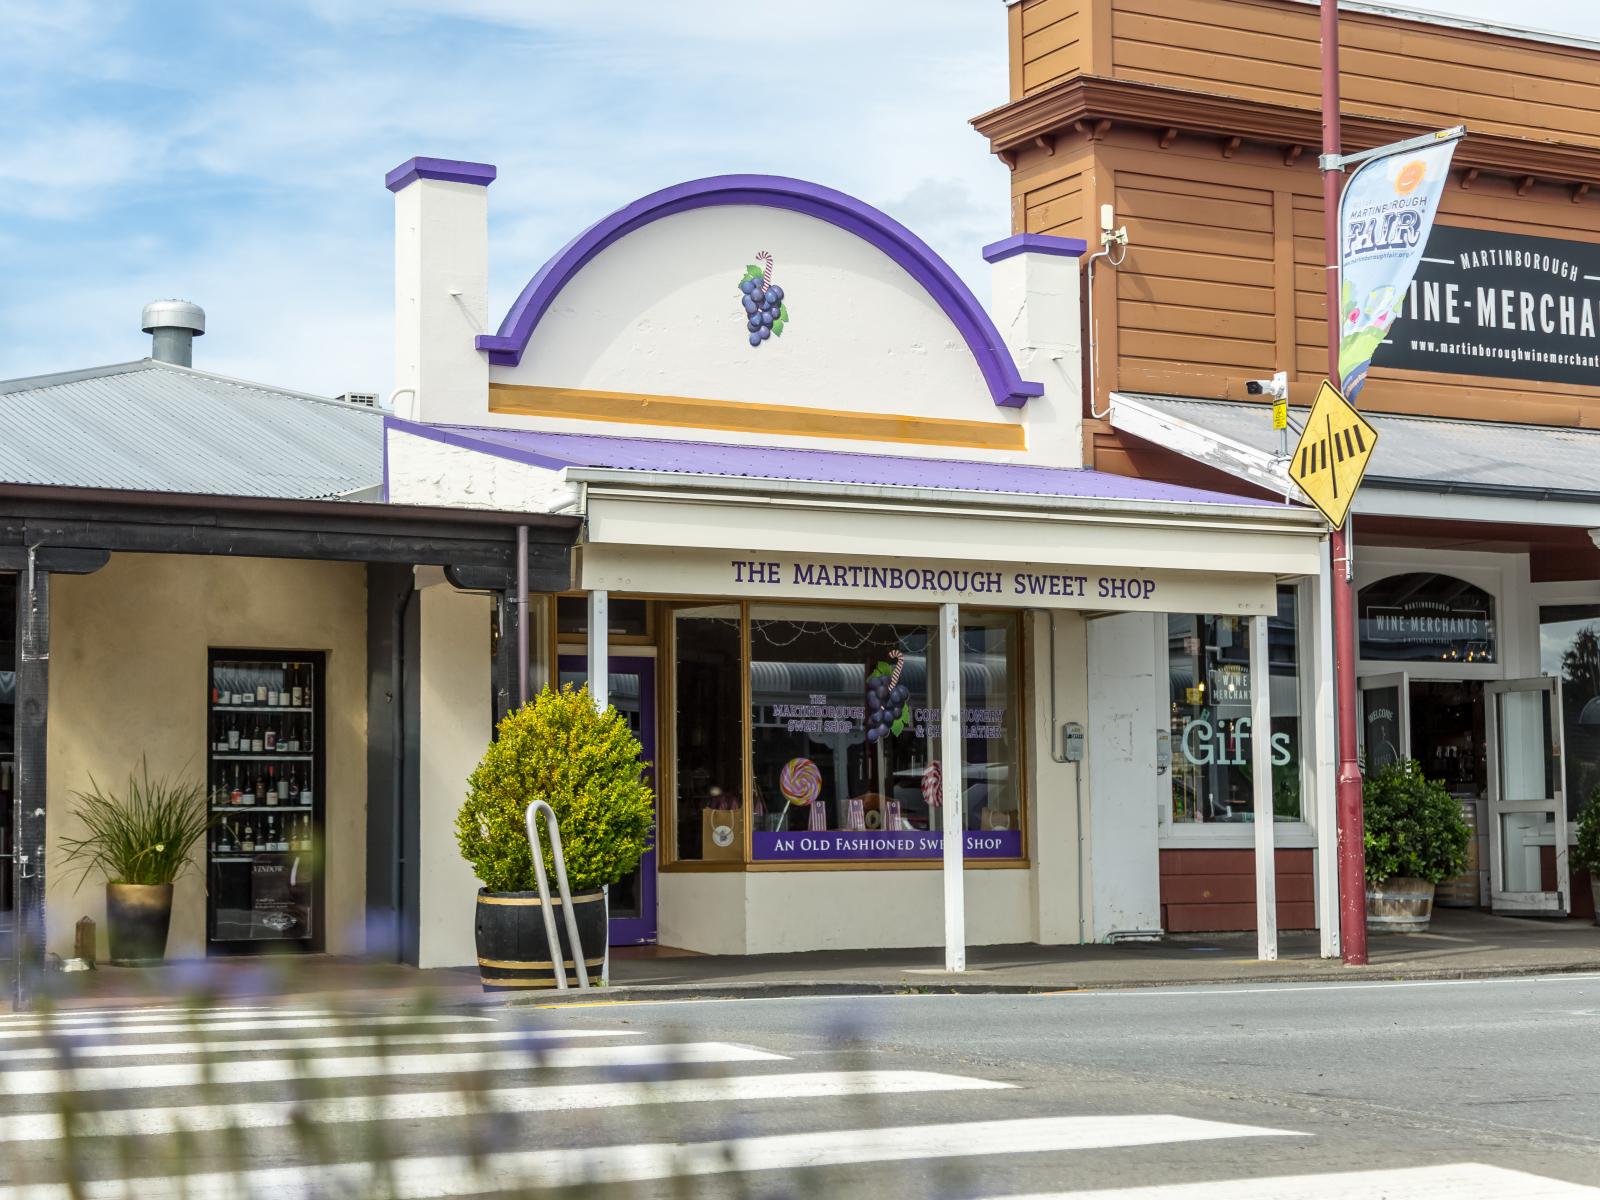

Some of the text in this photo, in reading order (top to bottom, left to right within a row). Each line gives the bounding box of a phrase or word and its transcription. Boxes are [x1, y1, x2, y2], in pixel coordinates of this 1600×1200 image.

[1344, 210, 1422, 259] FAIR
[1460, 249, 1578, 282] MARTINBOROUGH
[1396, 279, 1600, 338] INE-MERCHA
[1411, 340, 1600, 368] www.martinboroughwinemerchant
[731, 561, 1156, 600] THE MARTINBOROUGH SWEET SHOP
[1222, 674, 1248, 687] WINE
[773, 704, 866, 719] MARTINBOROUGH
[787, 719, 853, 733] SWEET SHOP
[915, 724, 925, 738] &
[1182, 717, 1291, 766] Gifs
